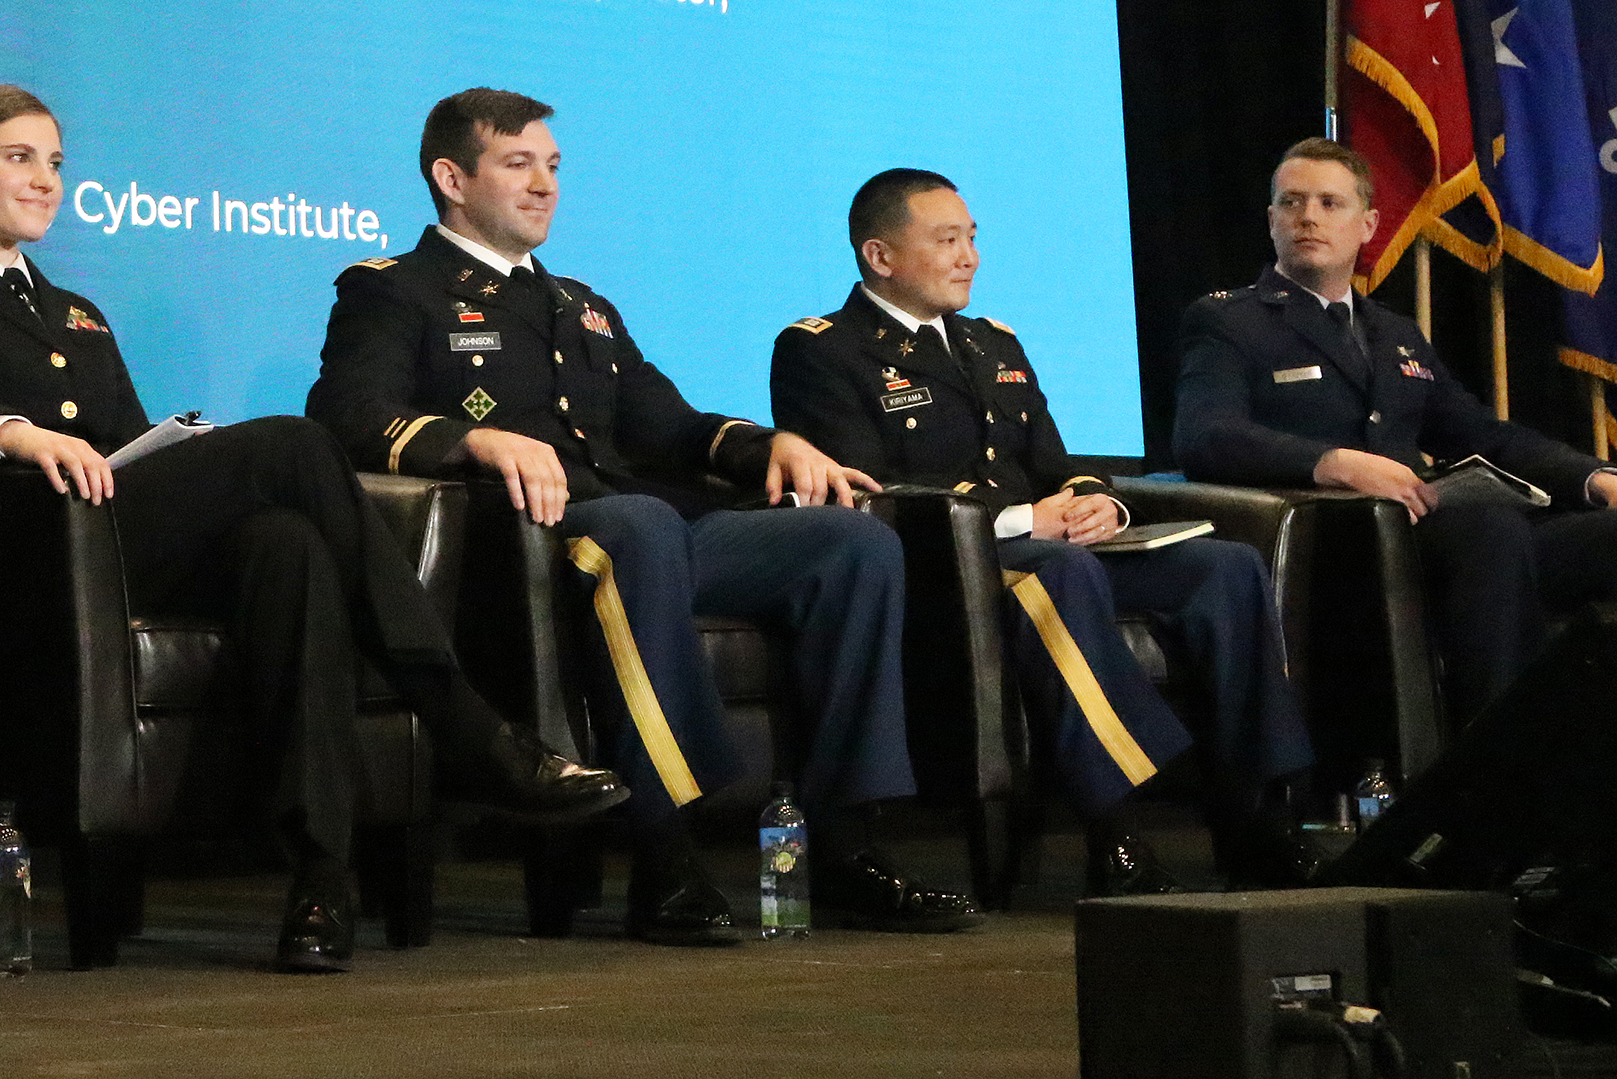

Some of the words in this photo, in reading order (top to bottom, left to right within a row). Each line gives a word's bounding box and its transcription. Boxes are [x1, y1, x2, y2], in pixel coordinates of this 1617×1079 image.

[74, 180, 200, 235] Cyber
[212, 190, 388, 250] Institute,
[457, 337, 494, 346] JOHNSON
[888, 393, 923, 406] KIRIYAMA
